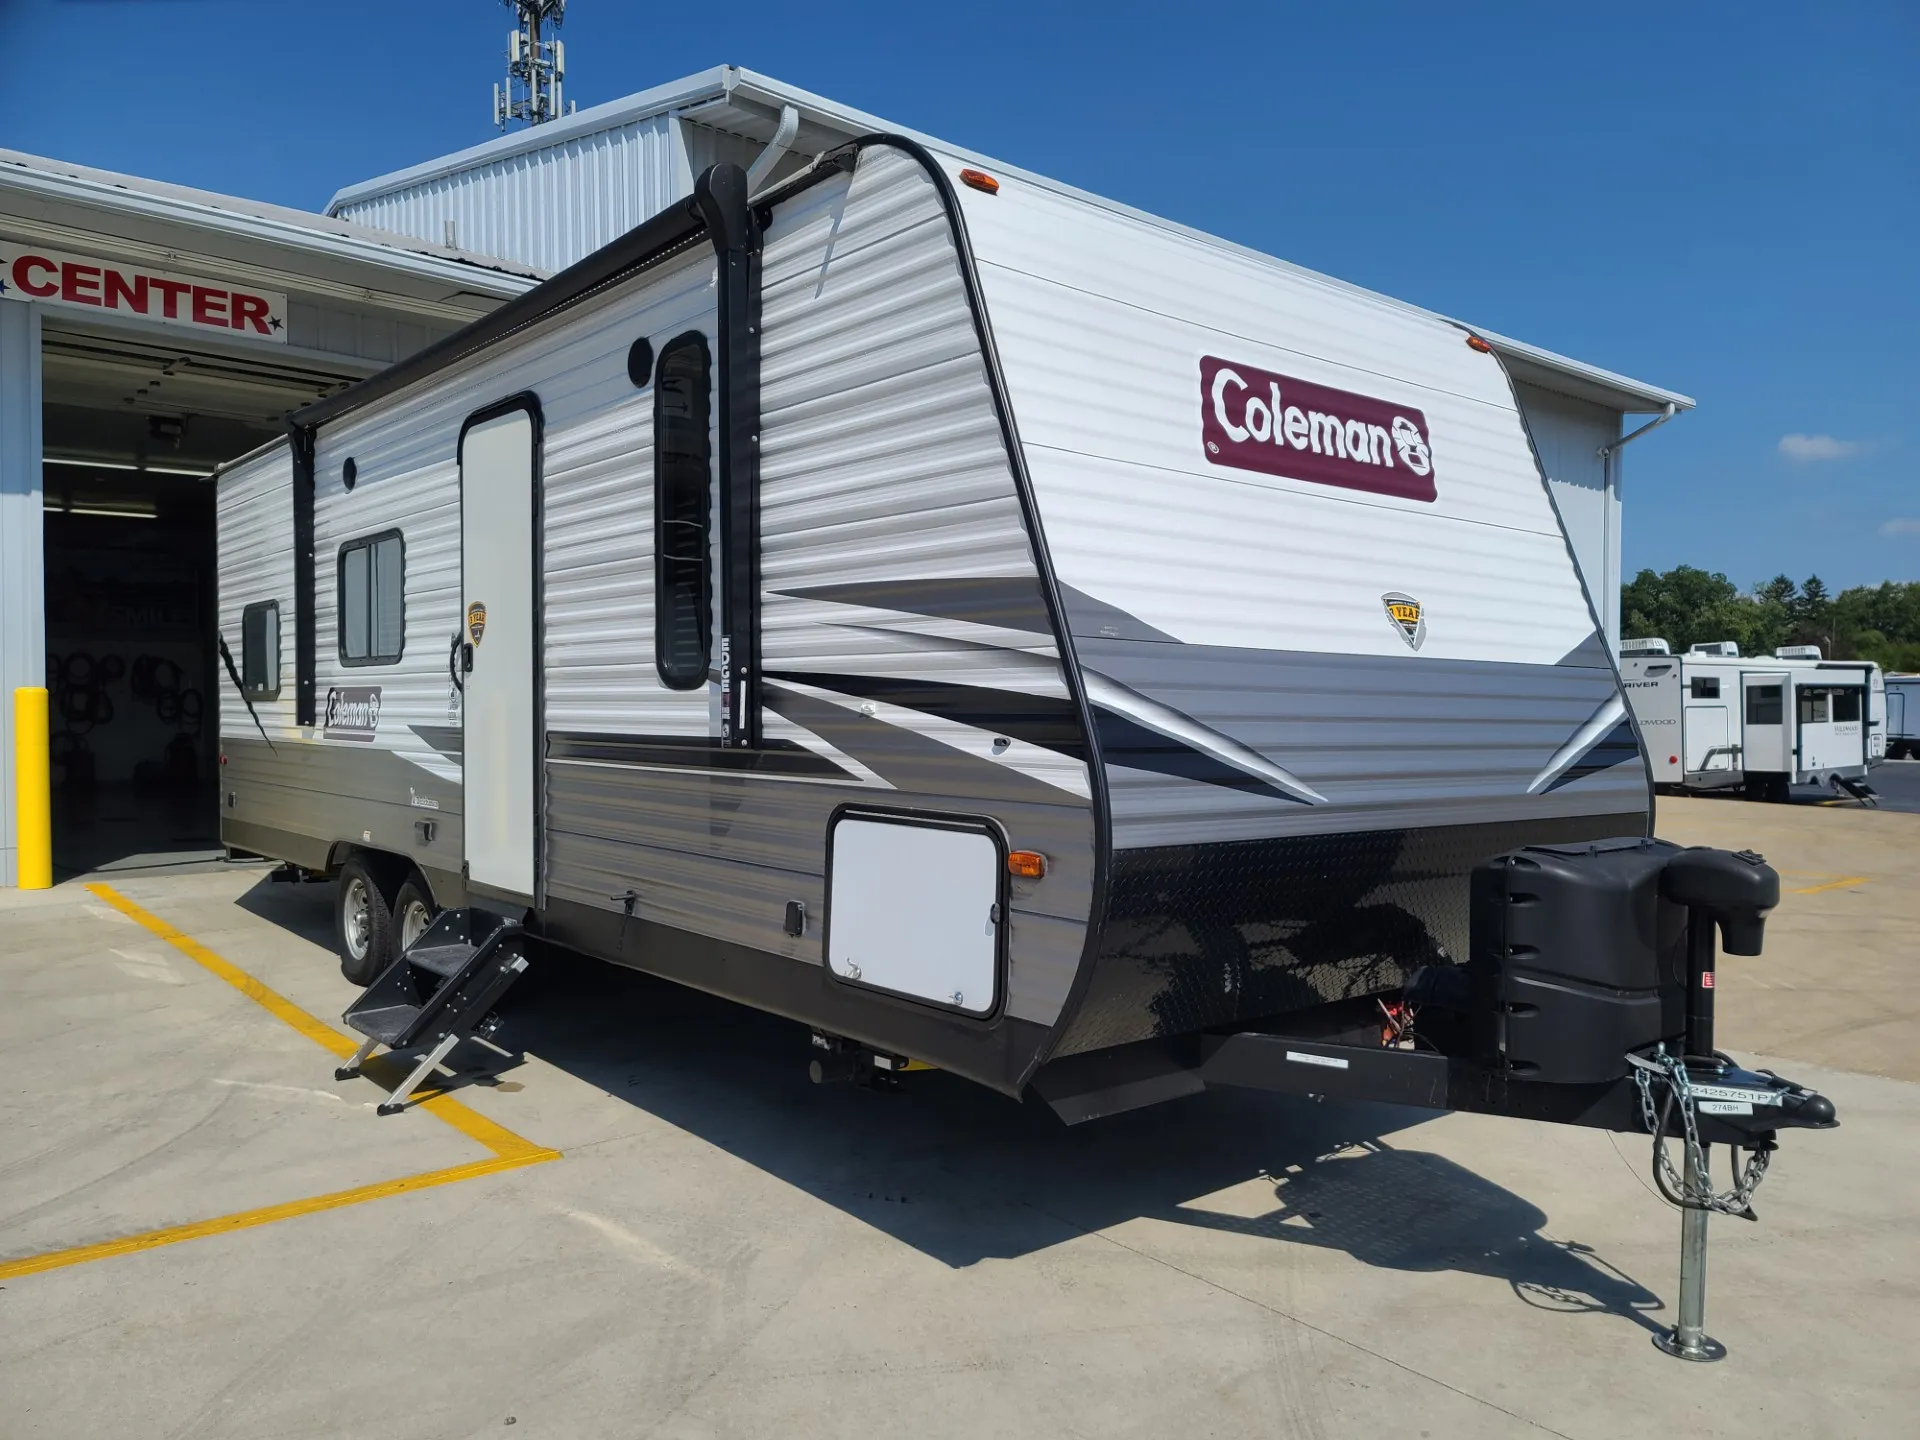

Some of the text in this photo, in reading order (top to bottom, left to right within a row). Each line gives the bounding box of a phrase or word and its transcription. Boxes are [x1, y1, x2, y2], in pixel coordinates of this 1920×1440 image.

[12, 255, 273, 335] CENTER
[1211, 368, 1395, 468] Coleman
[721, 637, 730, 693] EDGE
[328, 690, 369, 728] Coleman
[1712, 1104, 1739, 1112] 274BH
